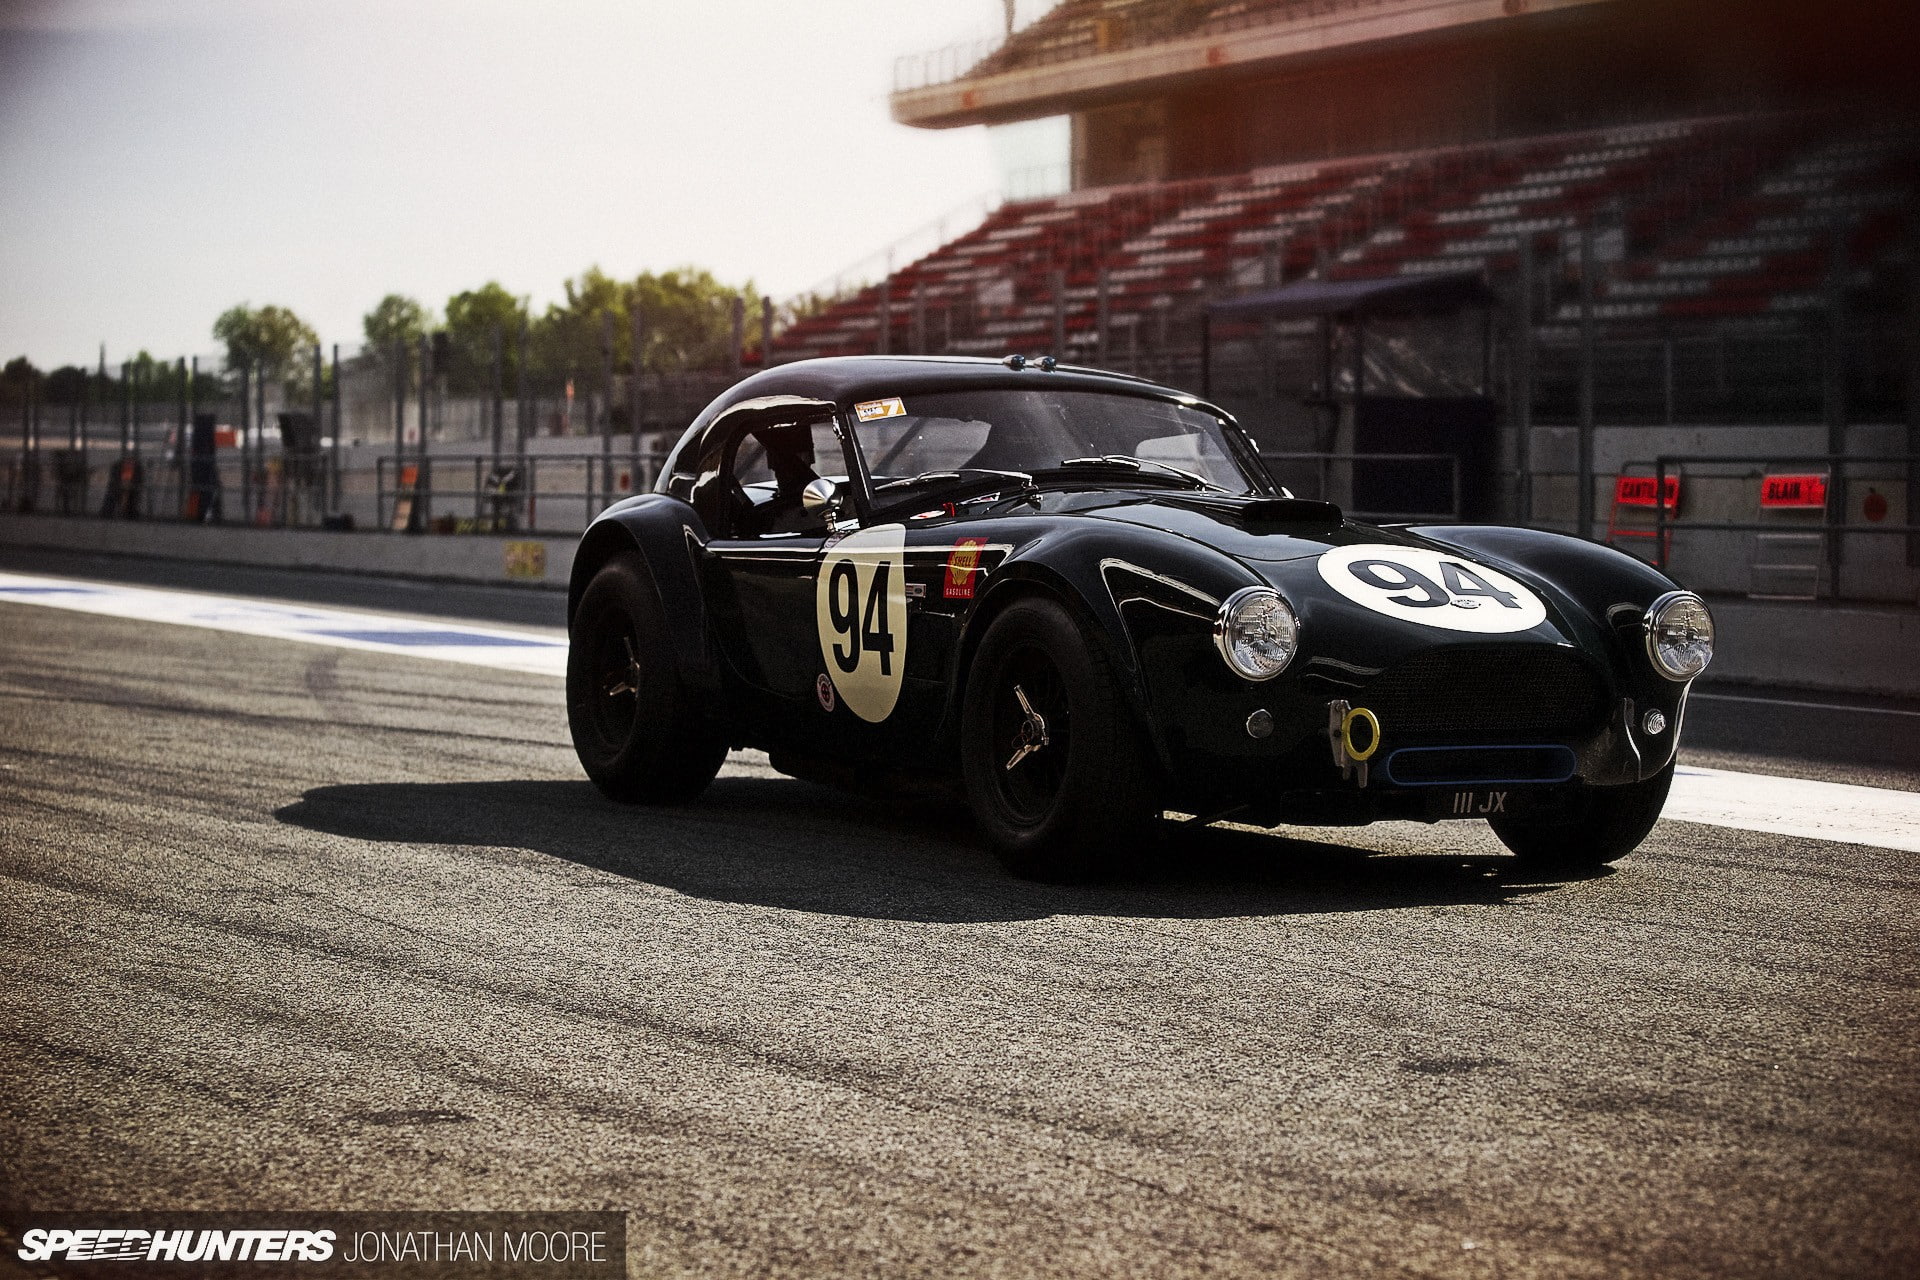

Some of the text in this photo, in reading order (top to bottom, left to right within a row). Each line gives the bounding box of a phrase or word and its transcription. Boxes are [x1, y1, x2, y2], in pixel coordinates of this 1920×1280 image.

[953, 556, 972, 567] SHELL
[945, 588, 971, 597] GASOLINE
[1347, 559, 1523, 609] 94
[828, 559, 895, 677] 94
[1478, 791, 1508, 813] JX
